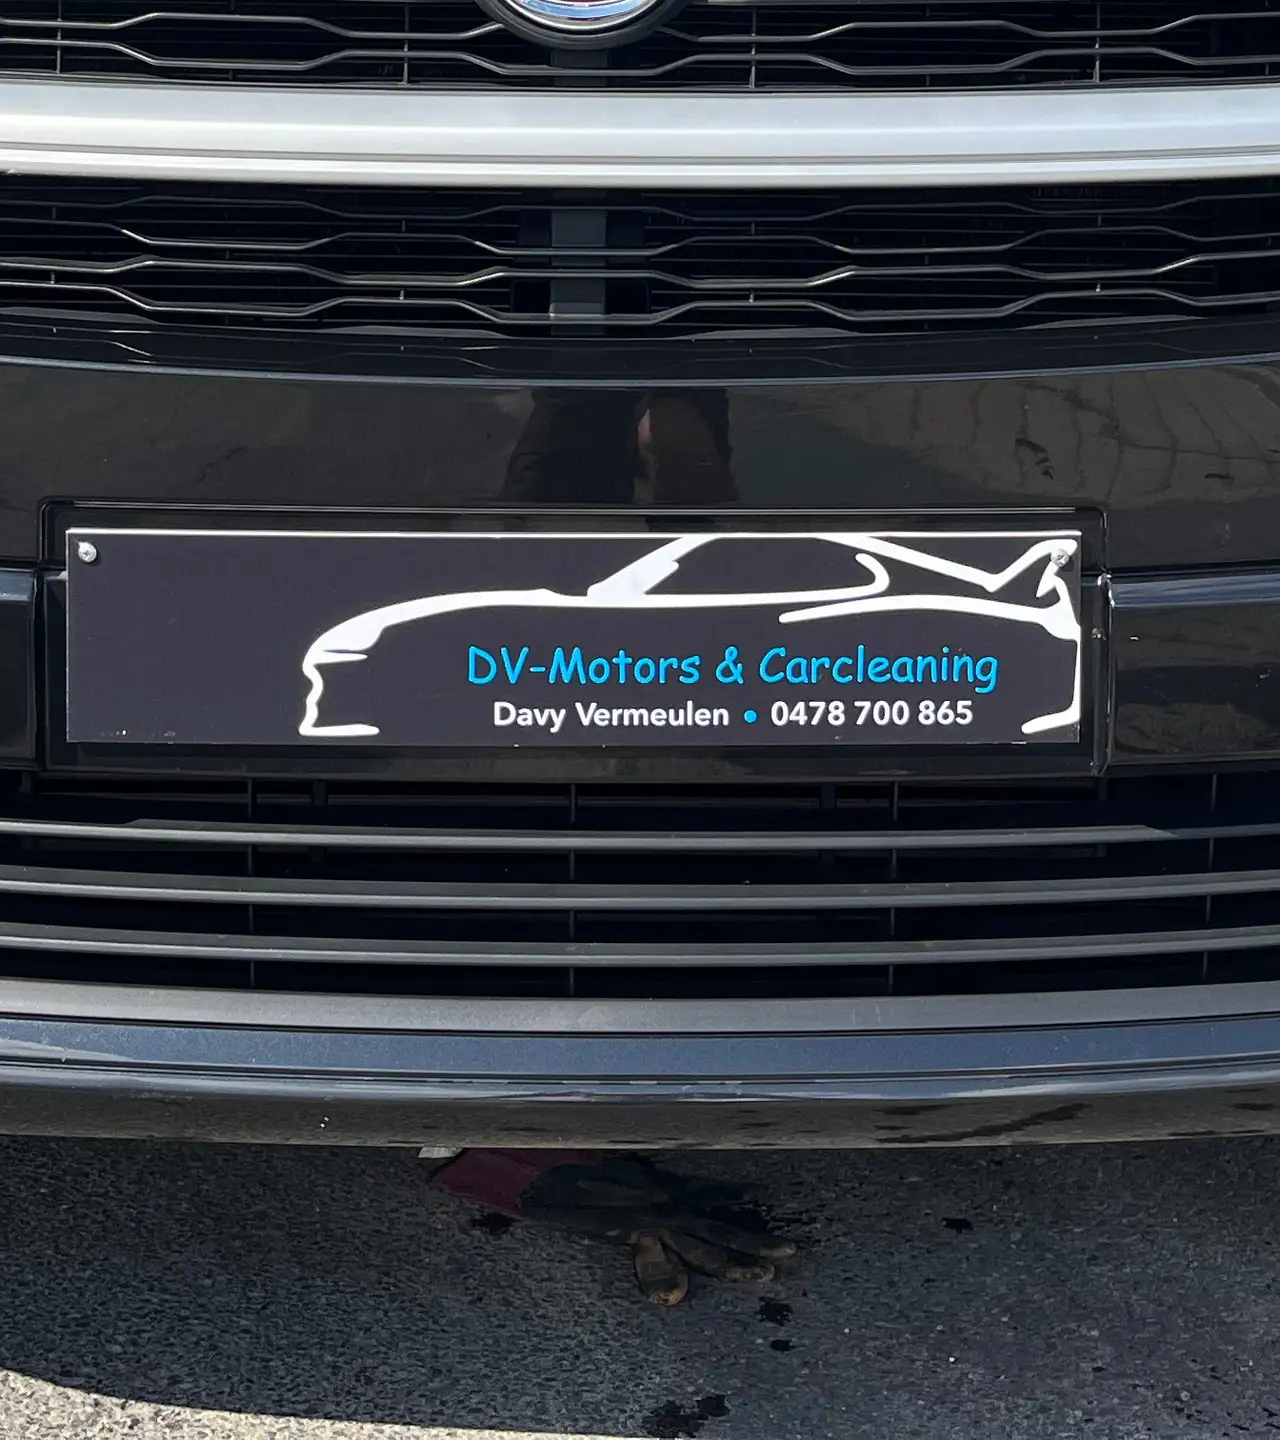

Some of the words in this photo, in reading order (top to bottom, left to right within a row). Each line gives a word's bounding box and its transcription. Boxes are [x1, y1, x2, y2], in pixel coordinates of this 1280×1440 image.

[467, 645, 702, 686] DV-Motors
[715, 645, 745, 685] &
[759, 644, 1000, 694] Carcleaning
[493, 701, 567, 734] Davy
[574, 700, 730, 727] Vermeulen
[770, 700, 846, 727] 0478
[853, 700, 911, 726] 700
[917, 699, 974, 726] 865
